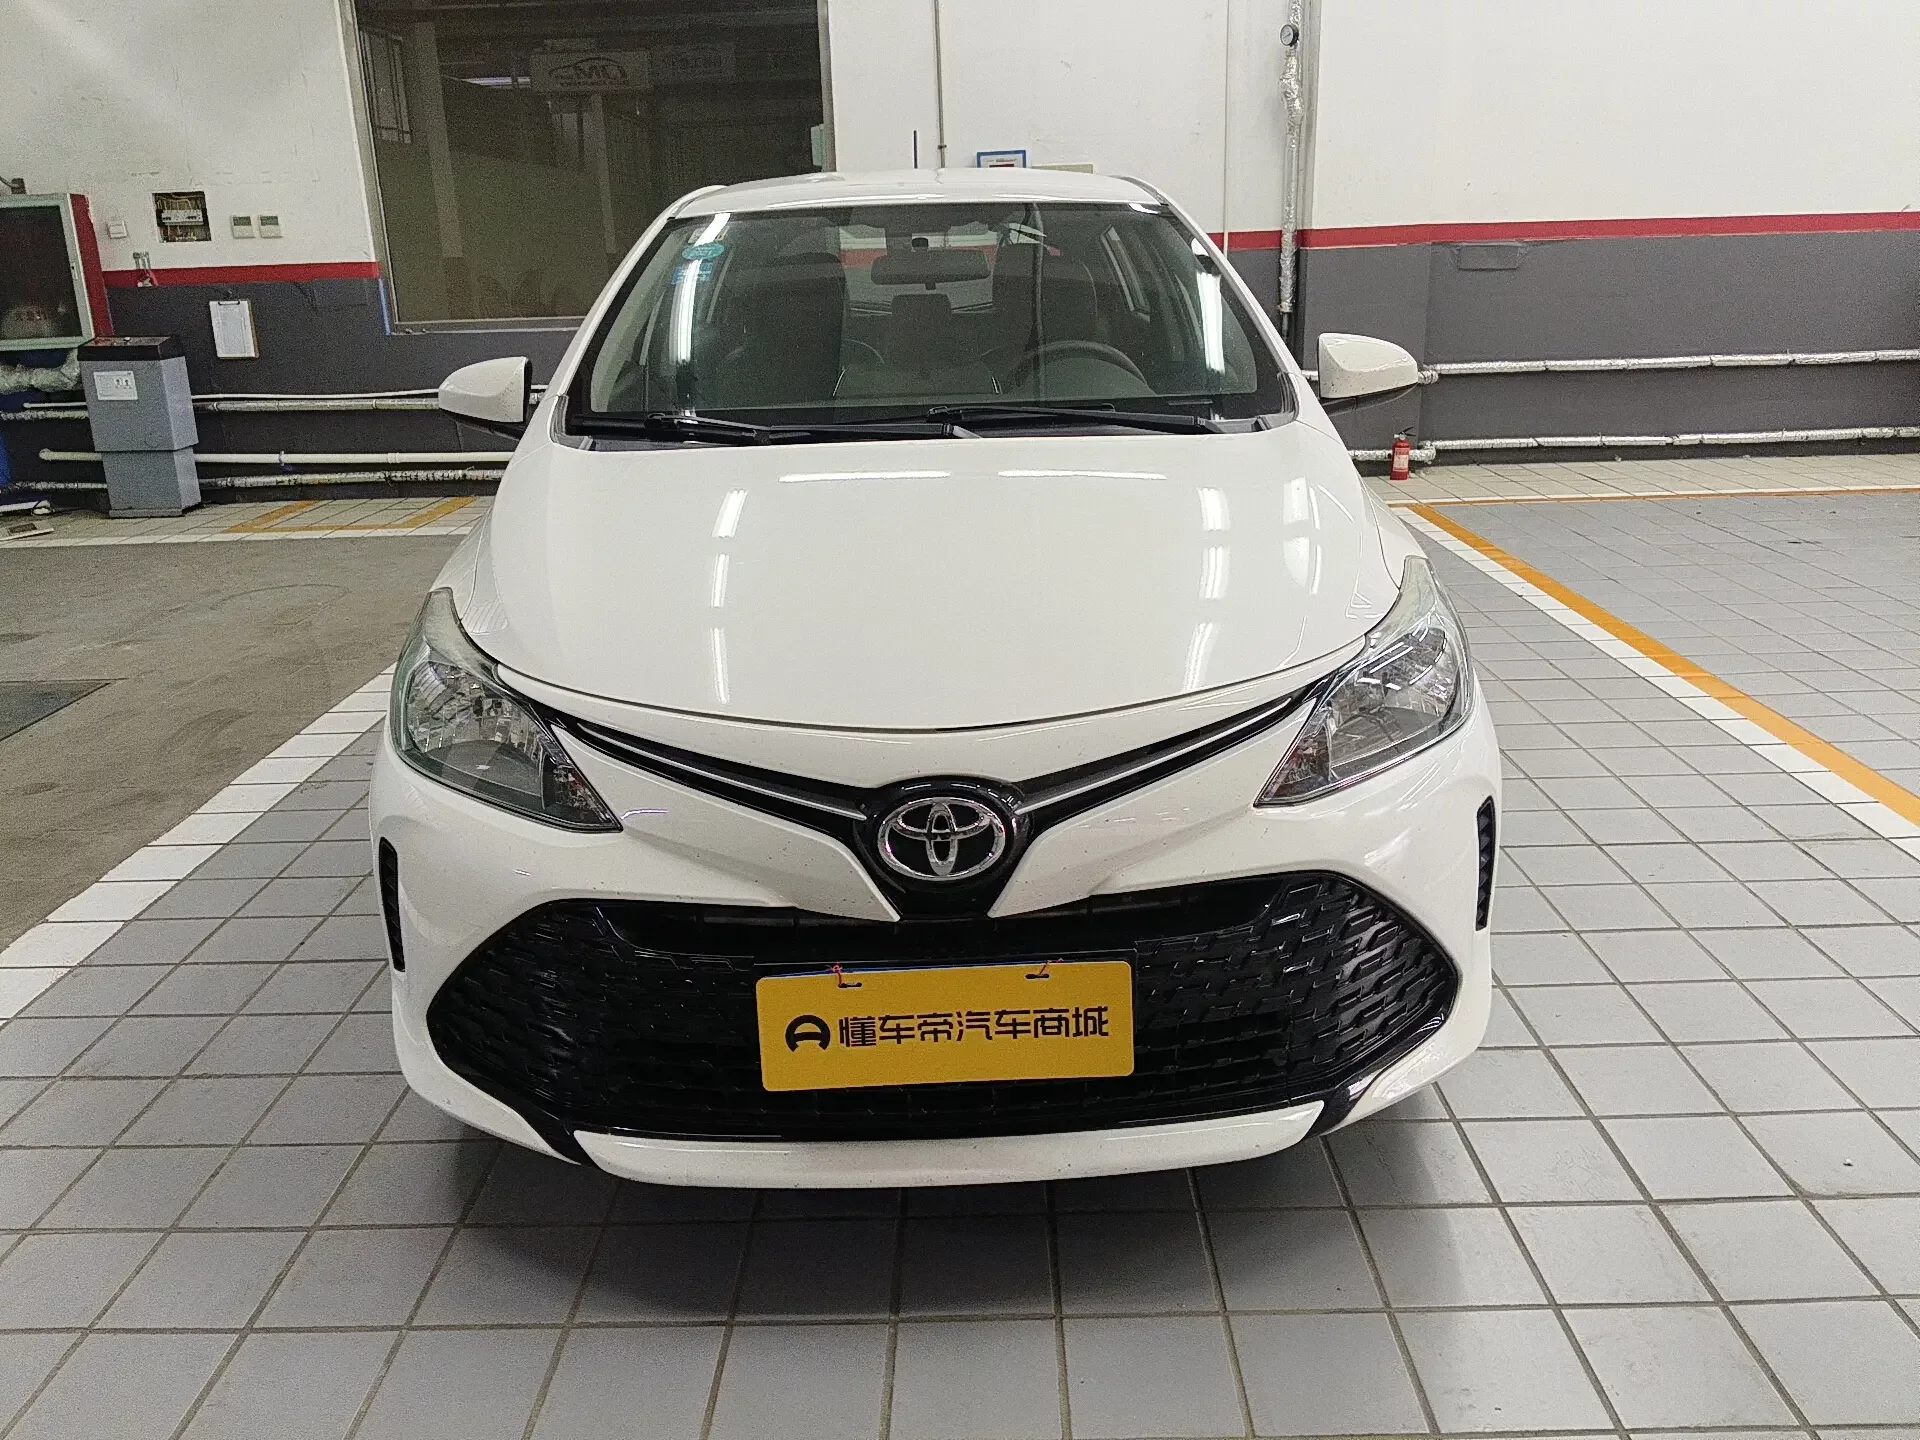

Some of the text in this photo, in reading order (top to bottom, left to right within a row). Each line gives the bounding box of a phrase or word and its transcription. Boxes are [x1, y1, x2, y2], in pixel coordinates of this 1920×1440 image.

[838, 1006, 1109, 1048] 懂车帝汽车商城
